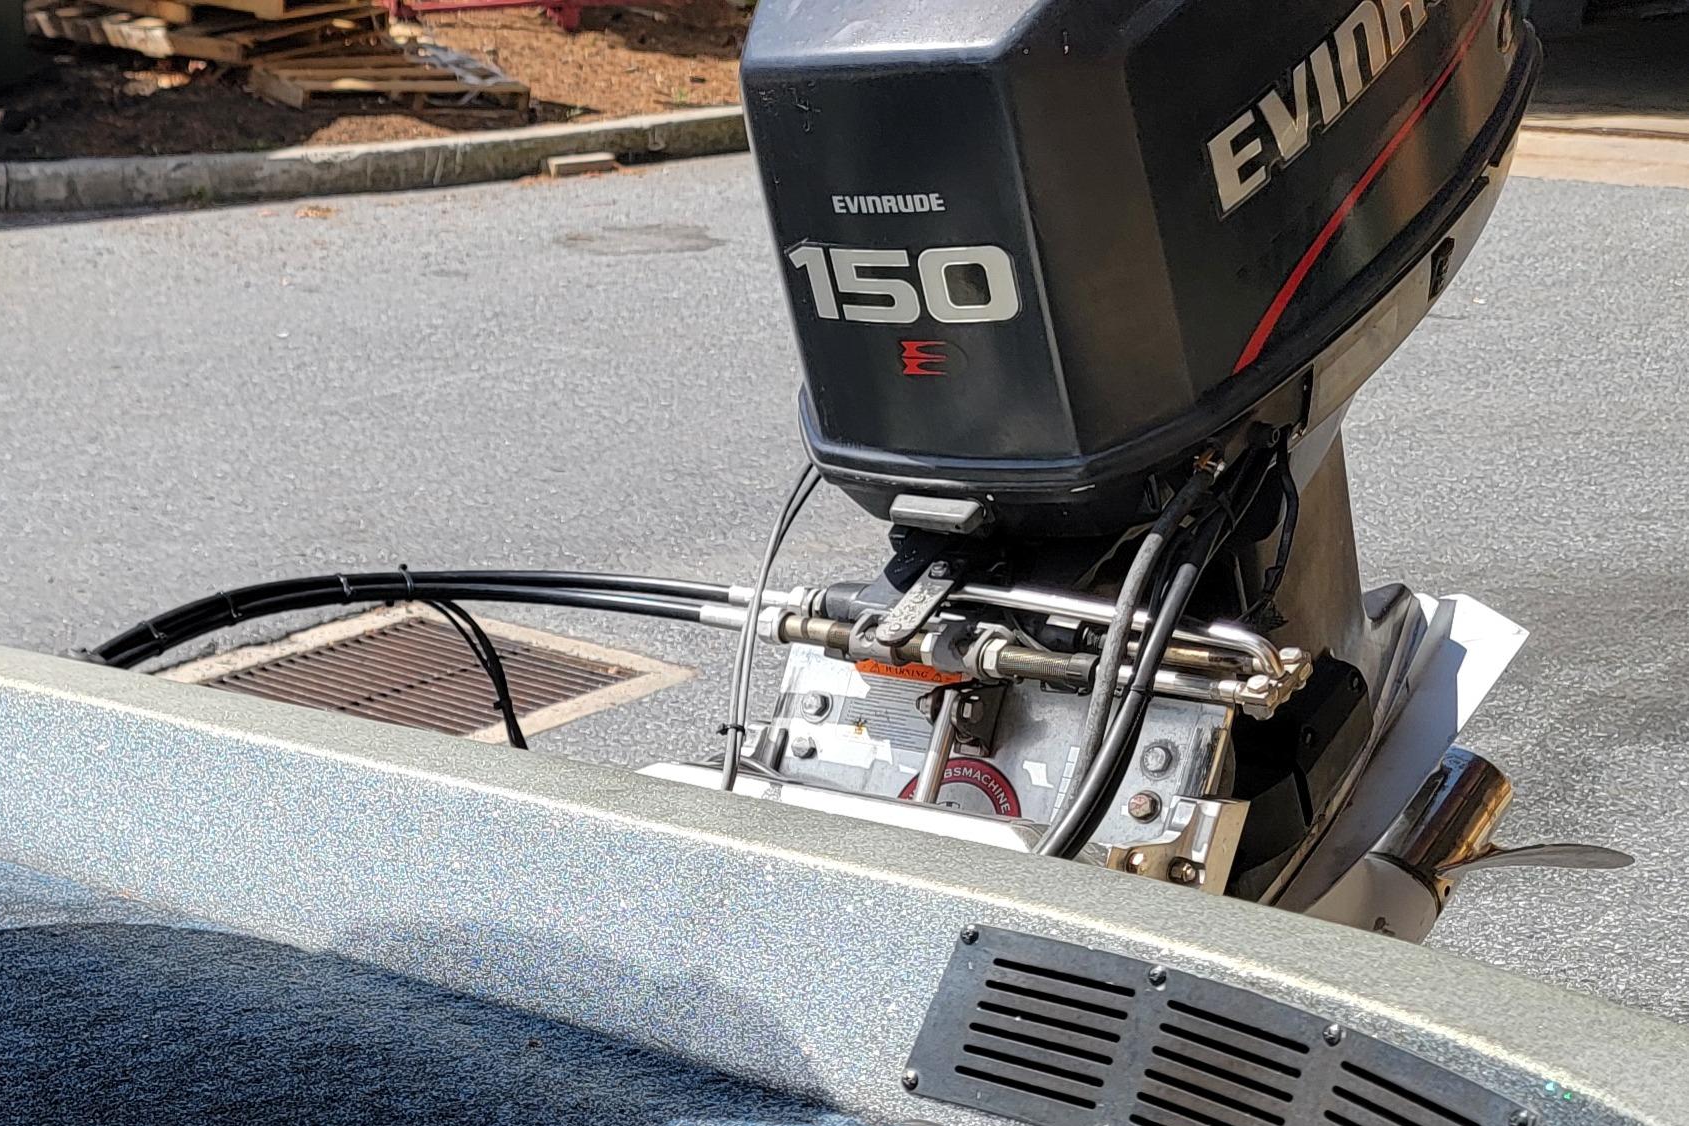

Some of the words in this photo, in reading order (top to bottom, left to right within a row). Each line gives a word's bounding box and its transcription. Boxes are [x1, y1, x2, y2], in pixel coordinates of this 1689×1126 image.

[830, 192, 947, 215] EVINRUDE
[787, 244, 1020, 325] 150
[885, 664, 929, 679] WARNING
